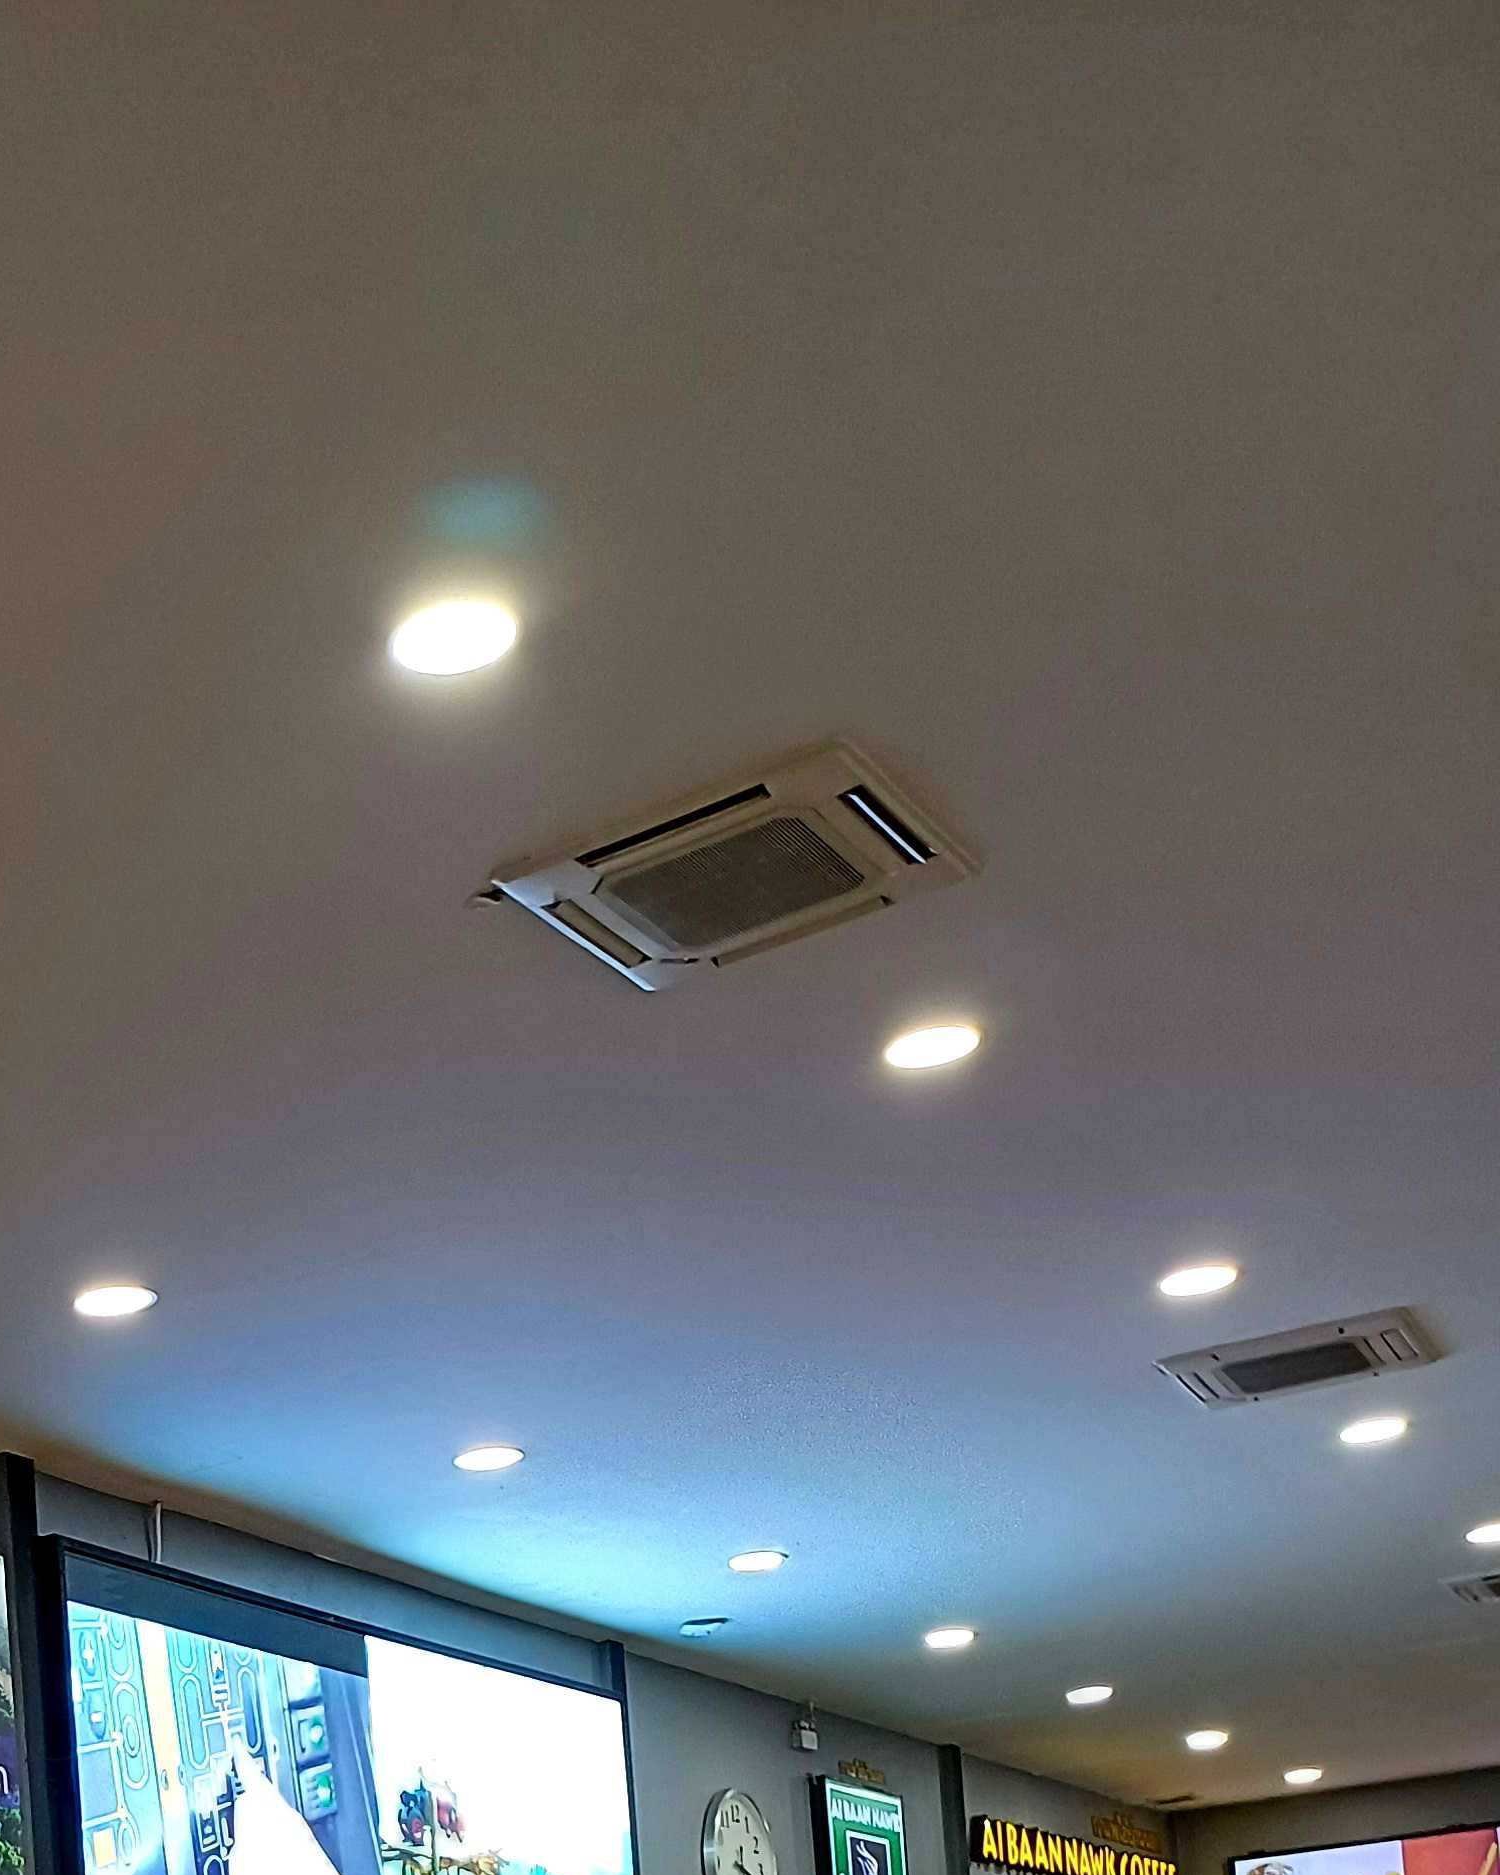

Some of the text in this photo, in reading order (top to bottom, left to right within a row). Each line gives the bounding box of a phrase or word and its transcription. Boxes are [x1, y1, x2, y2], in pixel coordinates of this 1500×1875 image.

[843, 1799, 872, 1826] BAAN
[982, 1818, 1004, 1863] AI
[1005, 1822, 1064, 1874] BAAN
